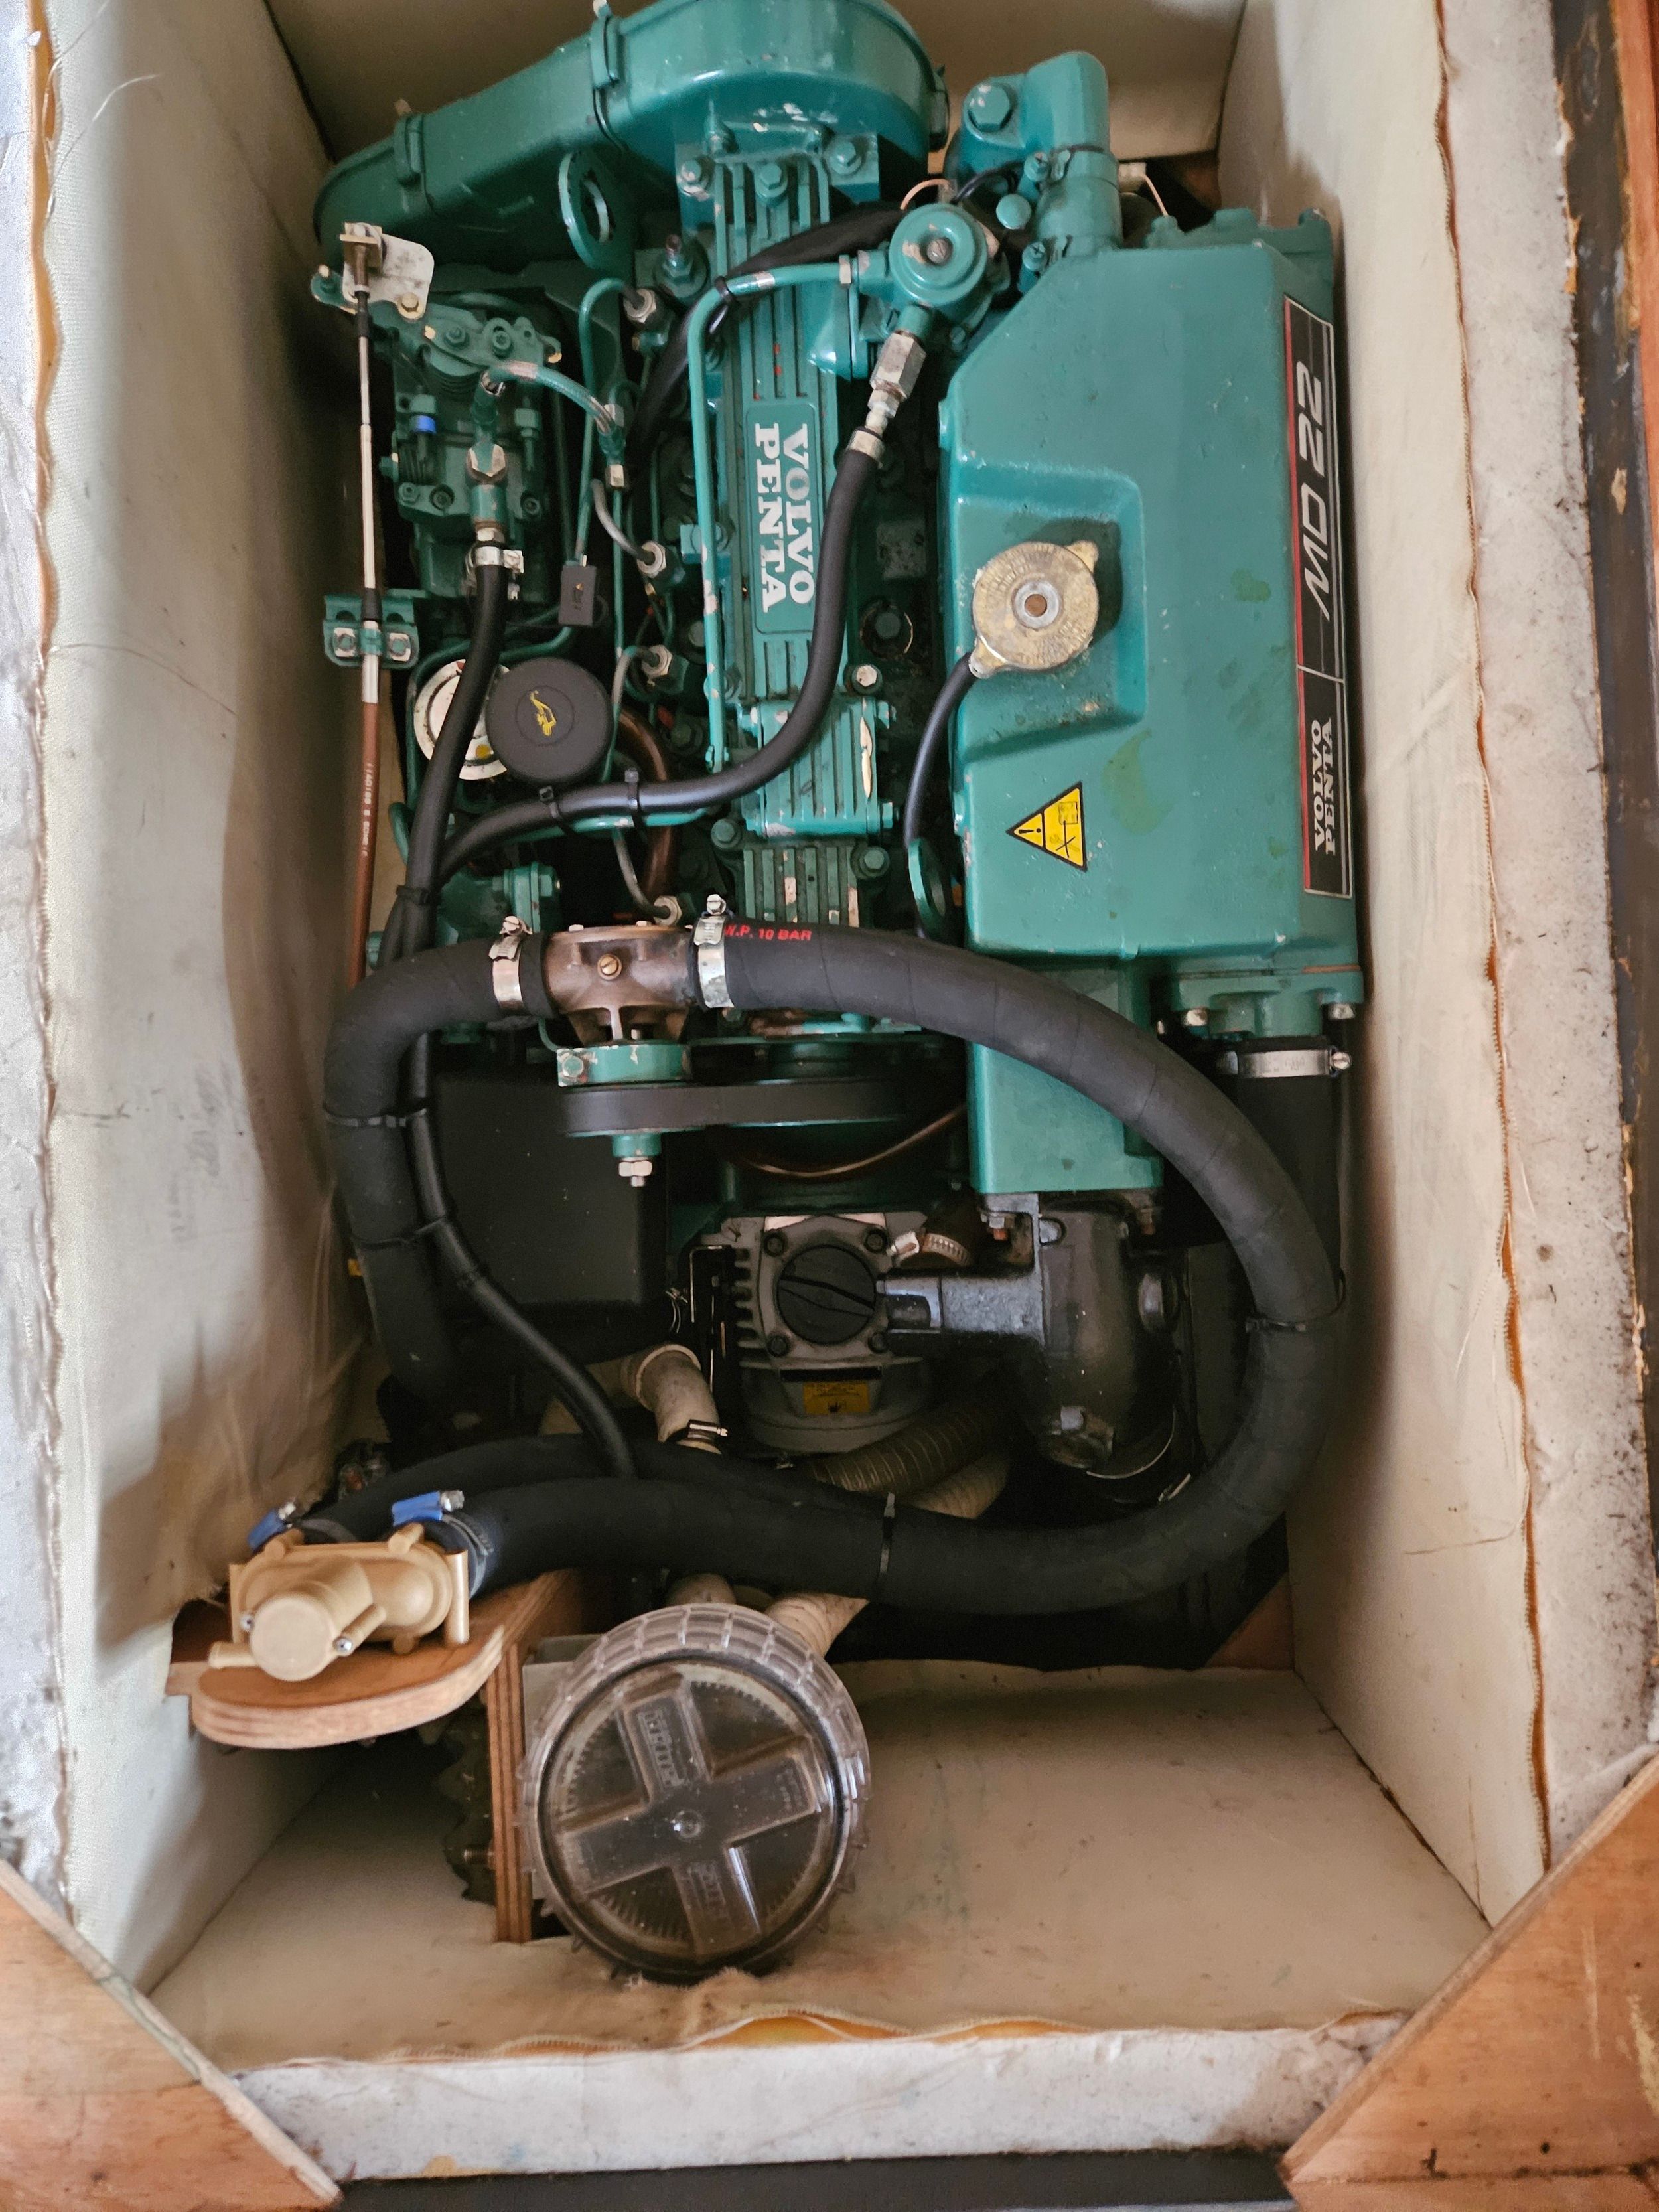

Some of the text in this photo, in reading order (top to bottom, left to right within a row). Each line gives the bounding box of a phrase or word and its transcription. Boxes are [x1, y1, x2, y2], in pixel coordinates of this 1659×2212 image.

[755, 423, 786, 613] PENTA
[784, 424, 814, 604] VOLVO
[1296, 360, 1330, 621] MD 22
[1311, 719, 1325, 851] VOLVO
[1321, 718, 1336, 856] PENTA
[758, 928, 775, 940] 10
[778, 929, 812, 941] BAR
